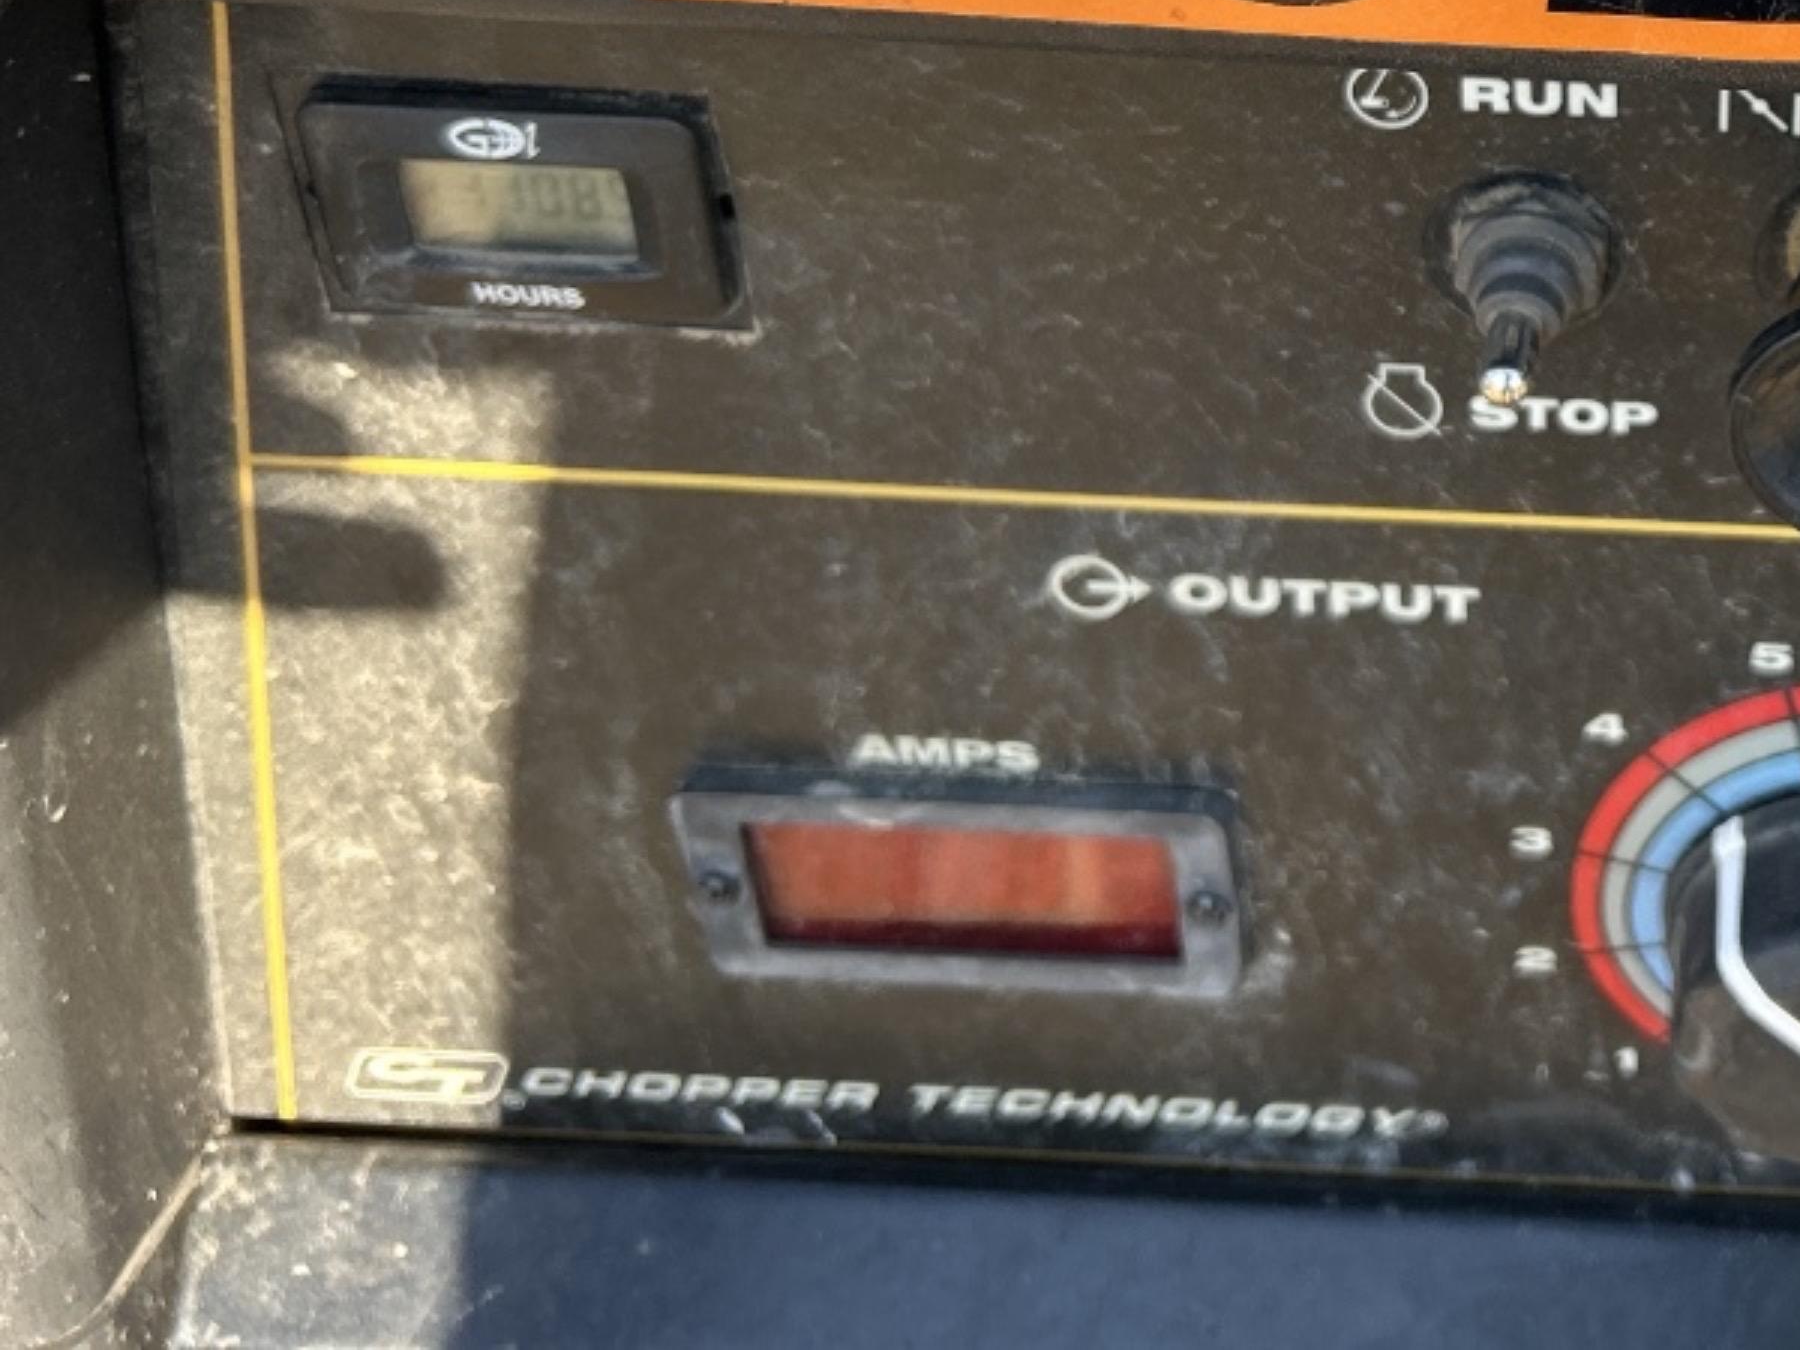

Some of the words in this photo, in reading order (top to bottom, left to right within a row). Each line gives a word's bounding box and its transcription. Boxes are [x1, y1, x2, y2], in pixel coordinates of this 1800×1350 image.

[1460, 77, 1619, 119] RUN
[471, 281, 585, 311] HOURS
[1468, 392, 1659, 436] STOP
[1168, 571, 1481, 624] OUTPUT
[1748, 641, 1795, 676] 5
[1582, 711, 1627, 745] 4
[852, 733, 1041, 775] AMPS
[1510, 825, 1554, 858] 3
[1513, 945, 1558, 977] 2
[1615, 1046, 1639, 1078] 1
[521, 1065, 879, 1113] CHOPPER
